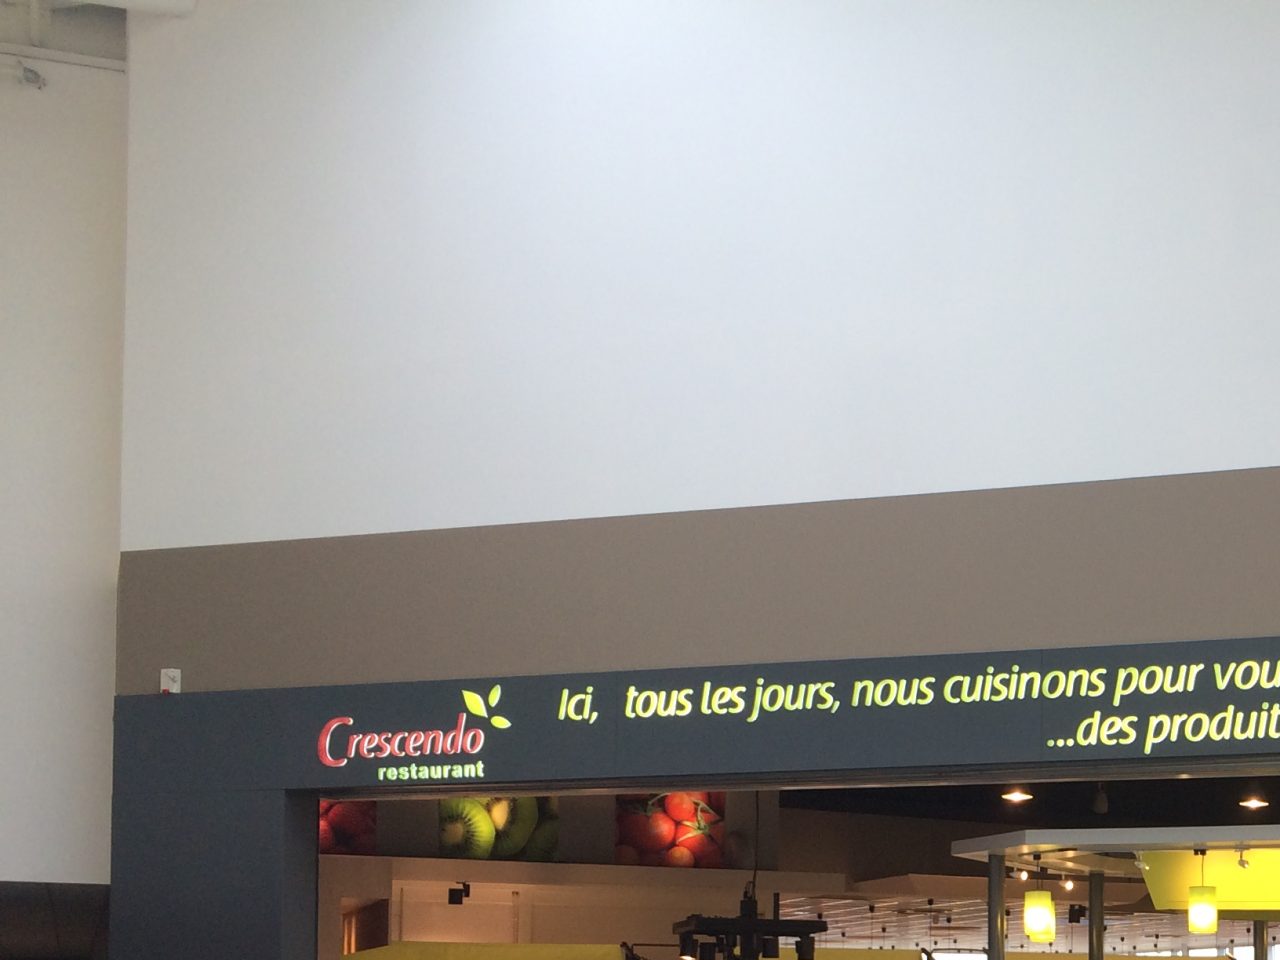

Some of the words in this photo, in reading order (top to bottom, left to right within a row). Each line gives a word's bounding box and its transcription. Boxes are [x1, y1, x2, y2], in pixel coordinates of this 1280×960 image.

[557, 685, 599, 724] Ici,
[624, 685, 694, 719] tous
[700, 680, 747, 715] les
[745, 678, 841, 722] jours,
[850, 676, 936, 708] nous
[942, 664, 1107, 705] cuisinons
[1112, 662, 1205, 706] pour
[317, 712, 486, 768] Crescendo
[1046, 709, 1139, 748] ...des
[377, 760, 485, 781] restaurant
